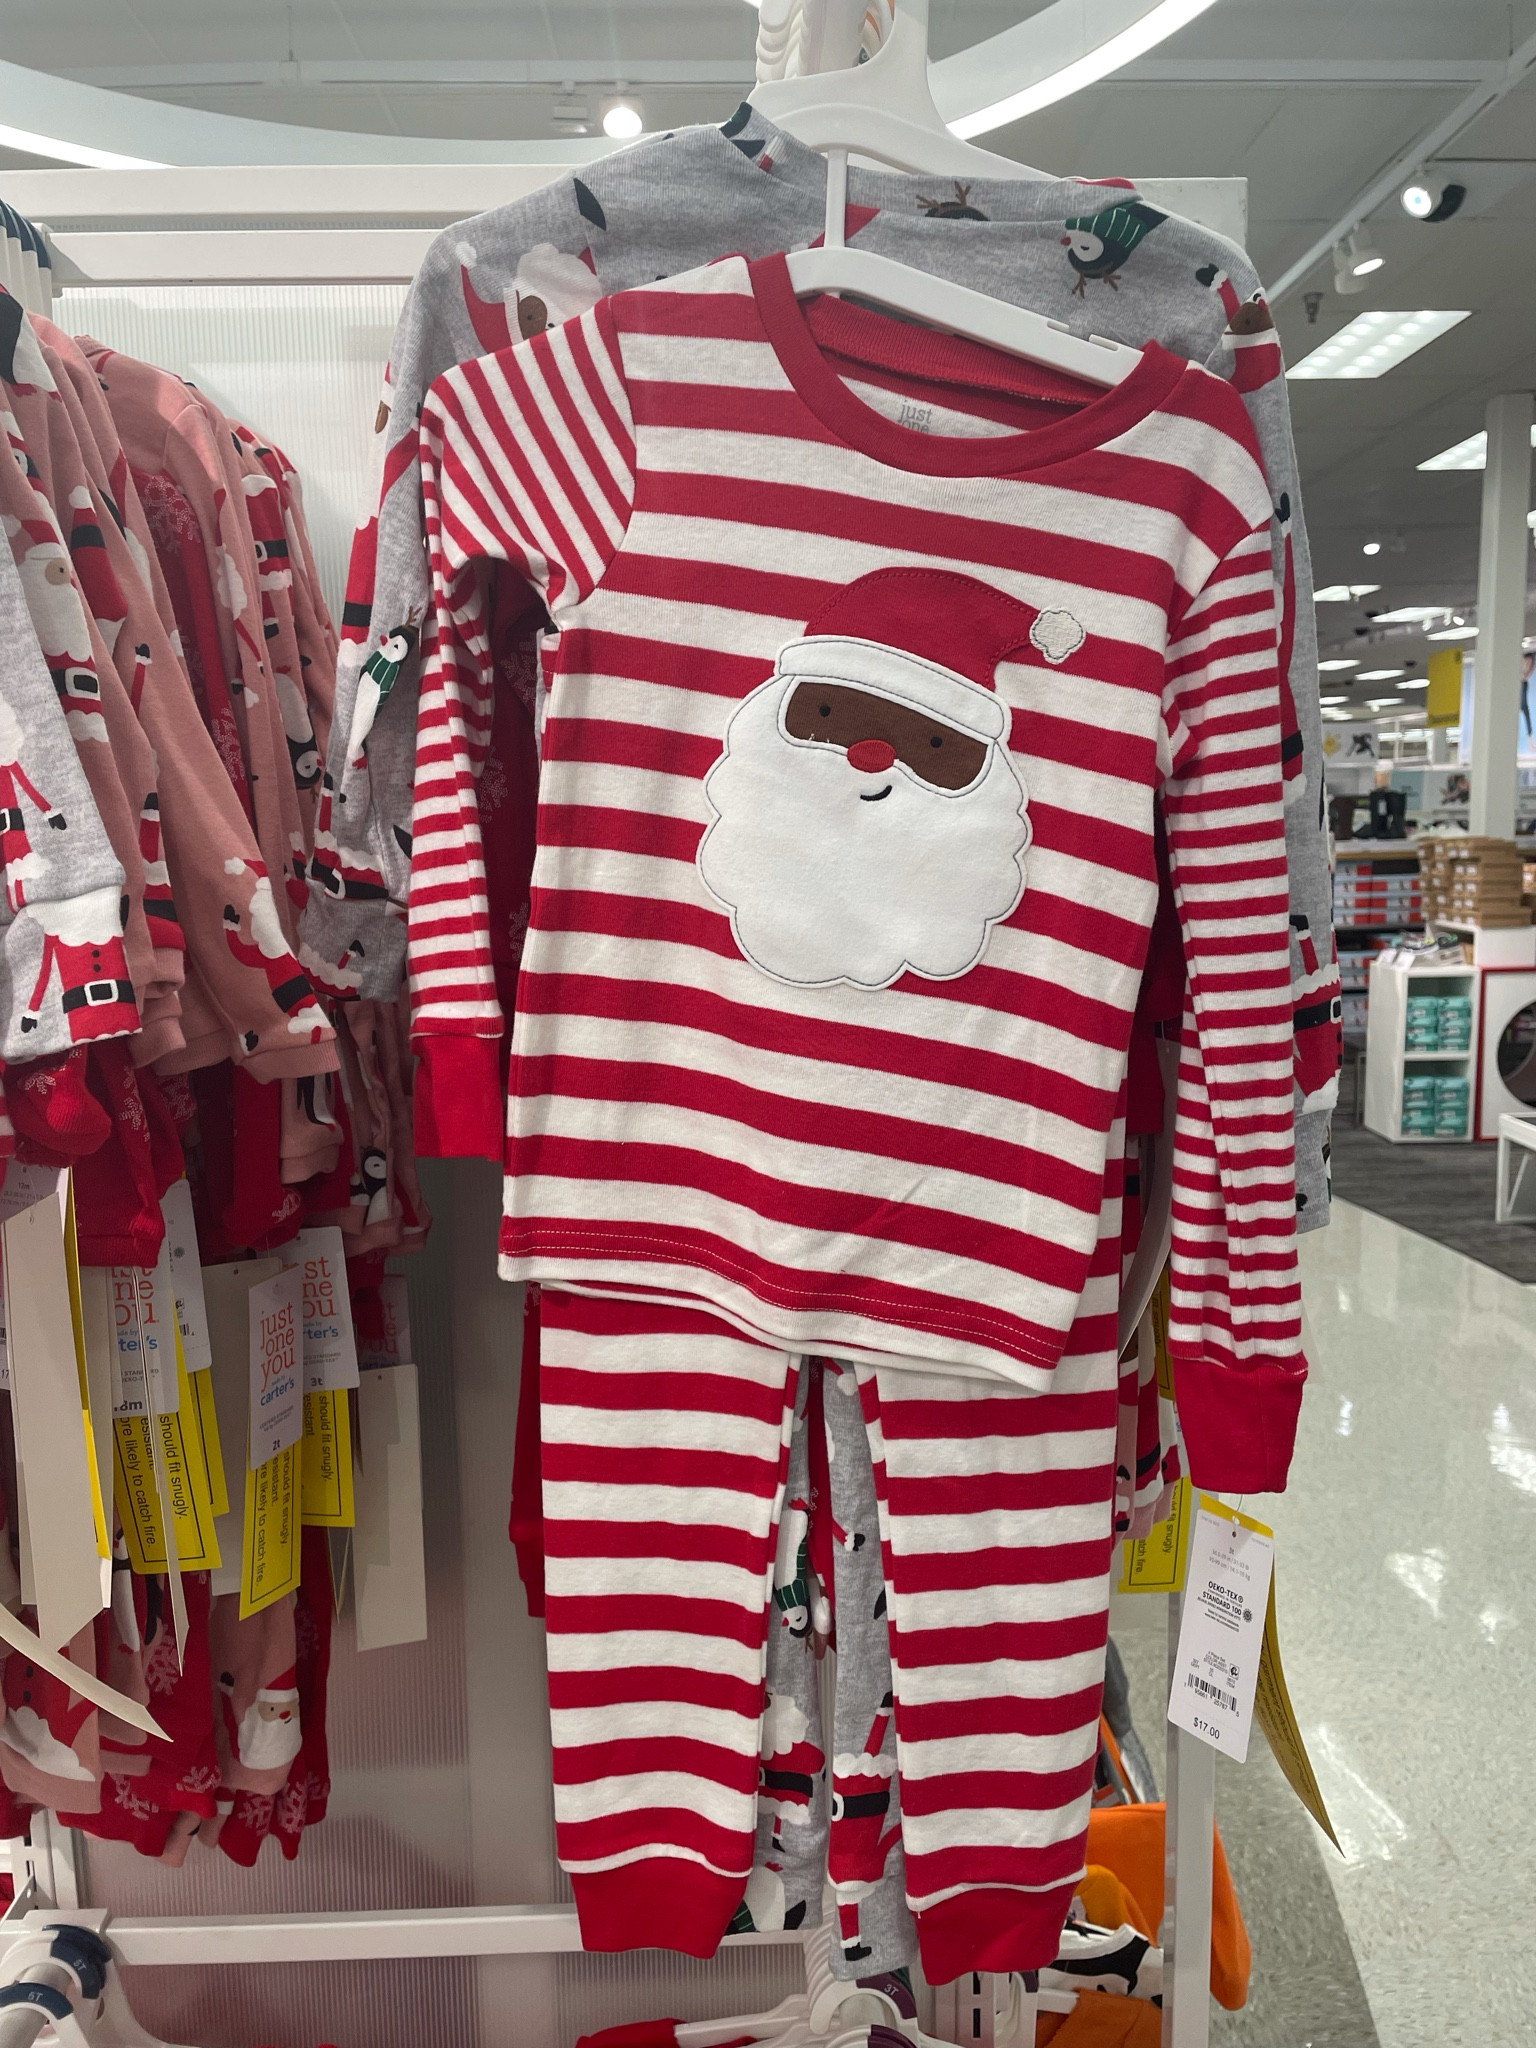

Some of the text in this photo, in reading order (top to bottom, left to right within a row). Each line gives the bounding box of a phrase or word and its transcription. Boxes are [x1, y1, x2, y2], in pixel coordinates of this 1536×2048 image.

[900, 399, 933, 424] just
[303, 1256, 332, 1279] st
[114, 1280, 155, 1300] ne
[303, 1281, 333, 1298] ne
[303, 1300, 337, 1319] ou
[260, 1302, 294, 1350] just
[265, 1328, 294, 1357] one
[261, 1347, 296, 1394] you
[260, 1377, 295, 1406] carter's
[319, 1395, 331, 1431] should
[322, 1434, 332, 1443] fit
[125, 1440, 141, 1470] likely
[160, 1415, 189, 1519] should fit snugly.
[132, 1474, 143, 1487] to
[135, 1489, 151, 1522] catch
[257, 1481, 268, 1511] likely
[258, 1529, 266, 1561] catch
[1203, 1591, 1230, 1610] STANDARD
[1232, 1605, 1242, 1616] 100
[1193, 1717, 1220, 1740] $17.00
[883, 1983, 899, 1996] 3T
